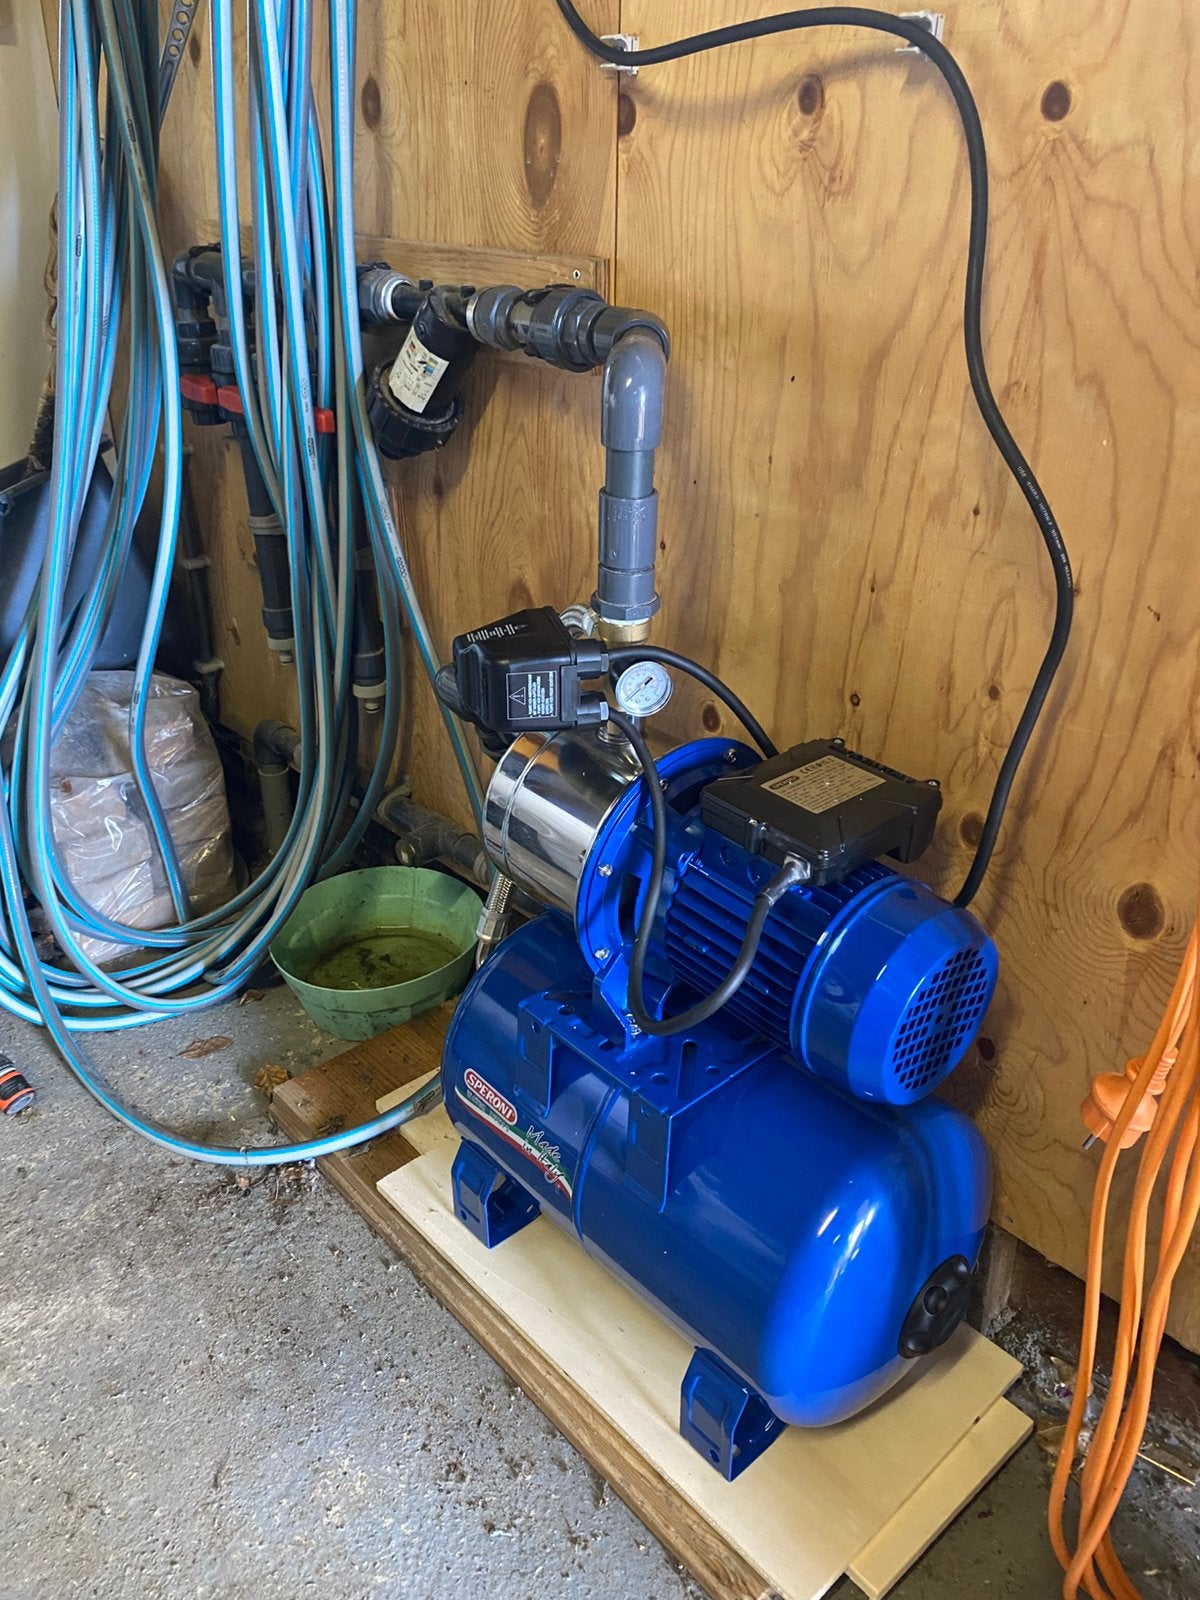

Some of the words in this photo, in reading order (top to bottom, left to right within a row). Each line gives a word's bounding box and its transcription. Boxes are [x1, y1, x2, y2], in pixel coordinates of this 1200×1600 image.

[467, 1073, 514, 1120] SPERONI
[521, 1138, 534, 1156] in
[537, 1150, 565, 1184] Italy
[526, 1125, 562, 1163] Made
